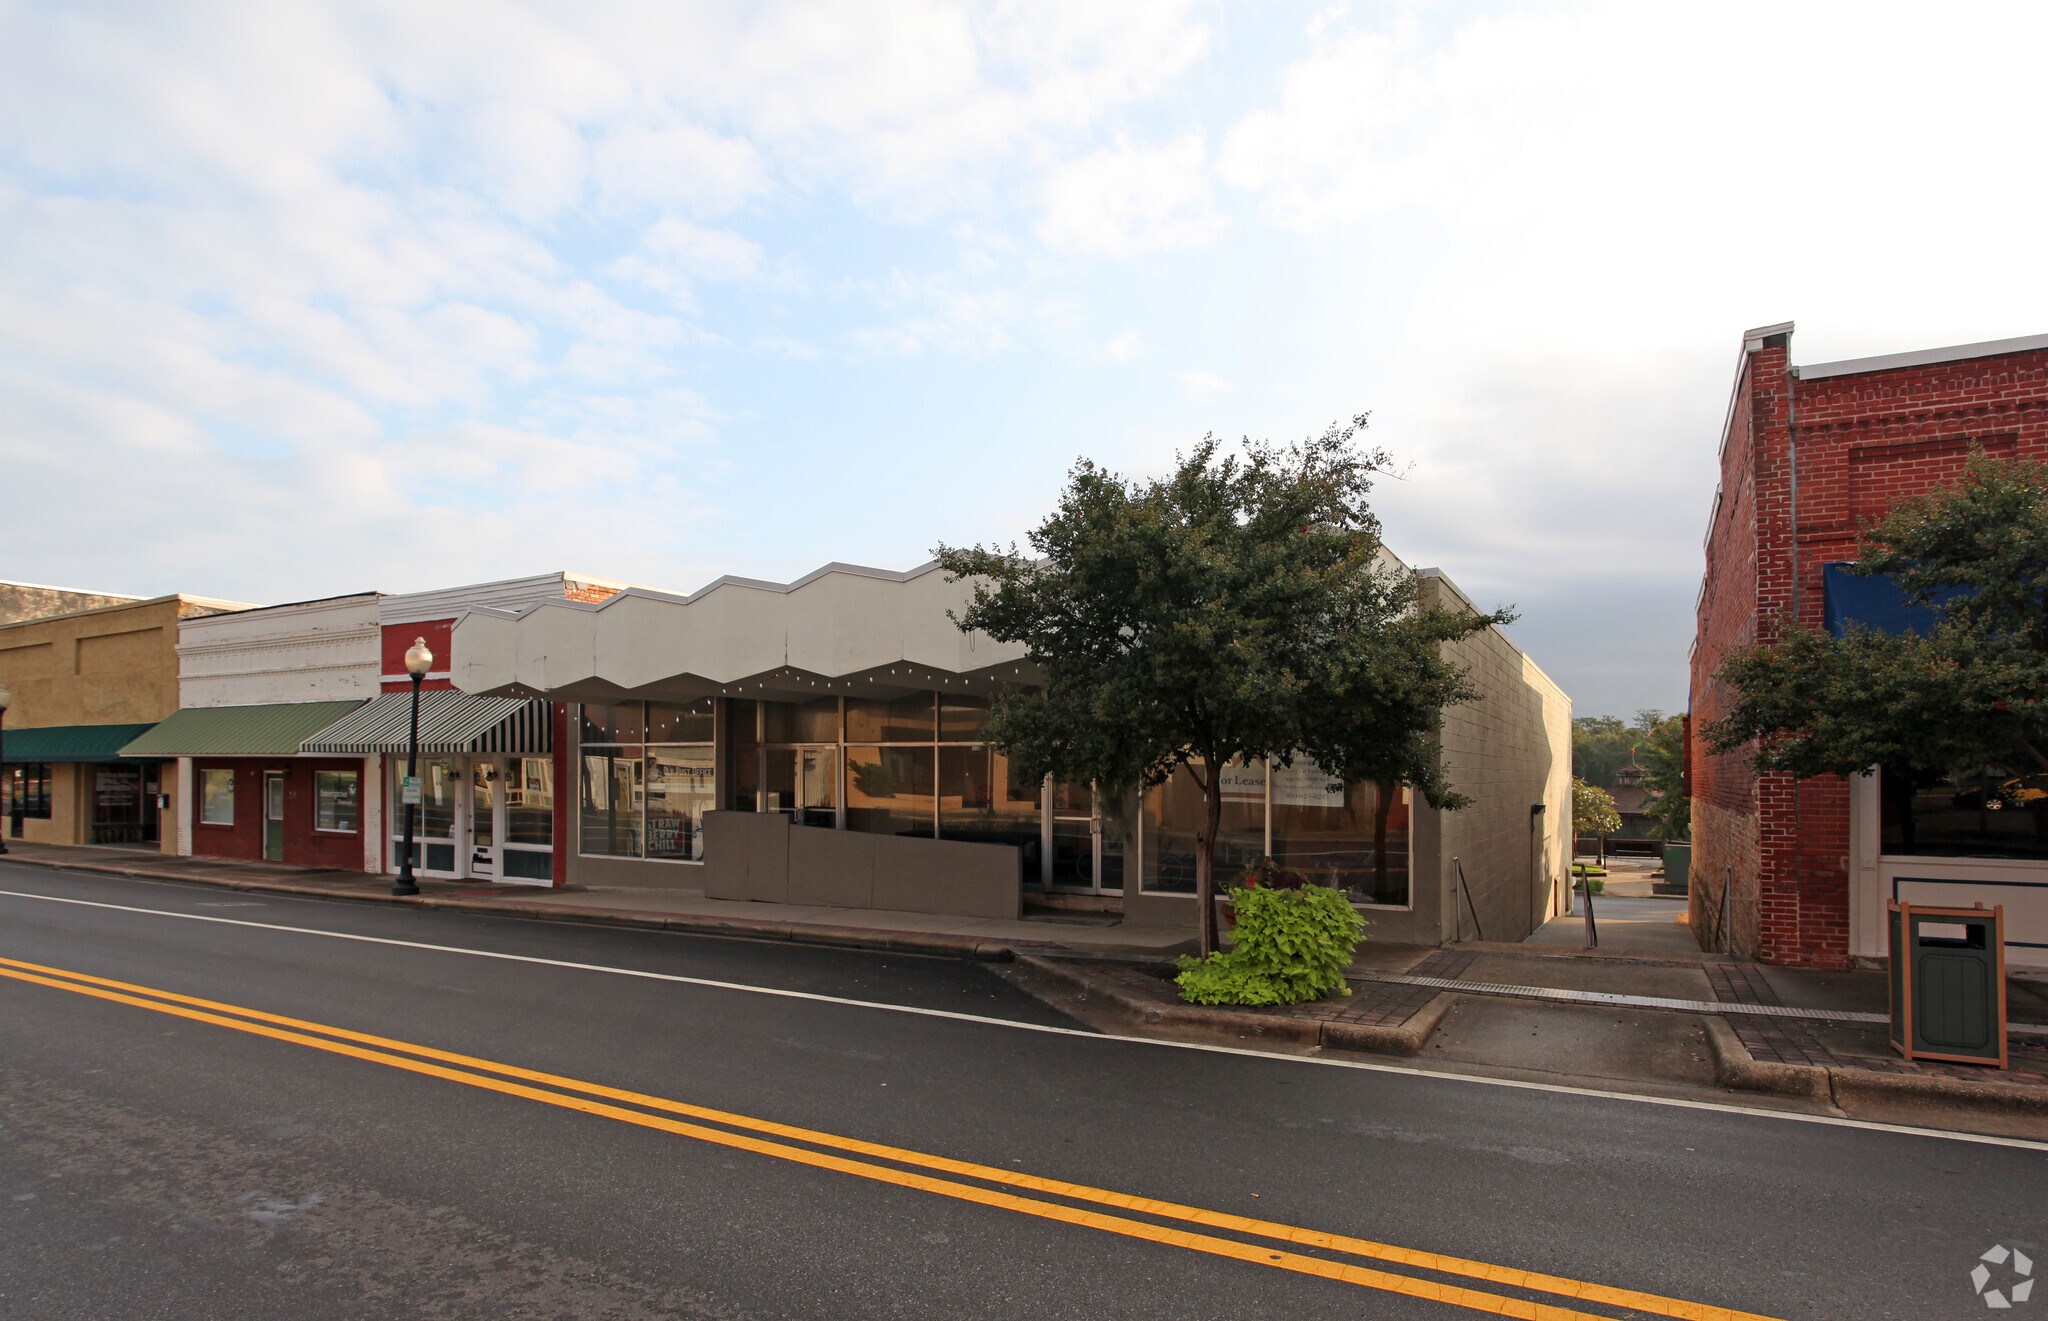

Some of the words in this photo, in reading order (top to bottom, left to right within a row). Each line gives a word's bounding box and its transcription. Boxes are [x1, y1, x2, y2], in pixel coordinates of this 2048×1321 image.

[675, 766, 691, 776] POST
[692, 767, 712, 776] OFFICE
[1234, 775, 1266, 787] Lease
[648, 839, 676, 851] CHILL
